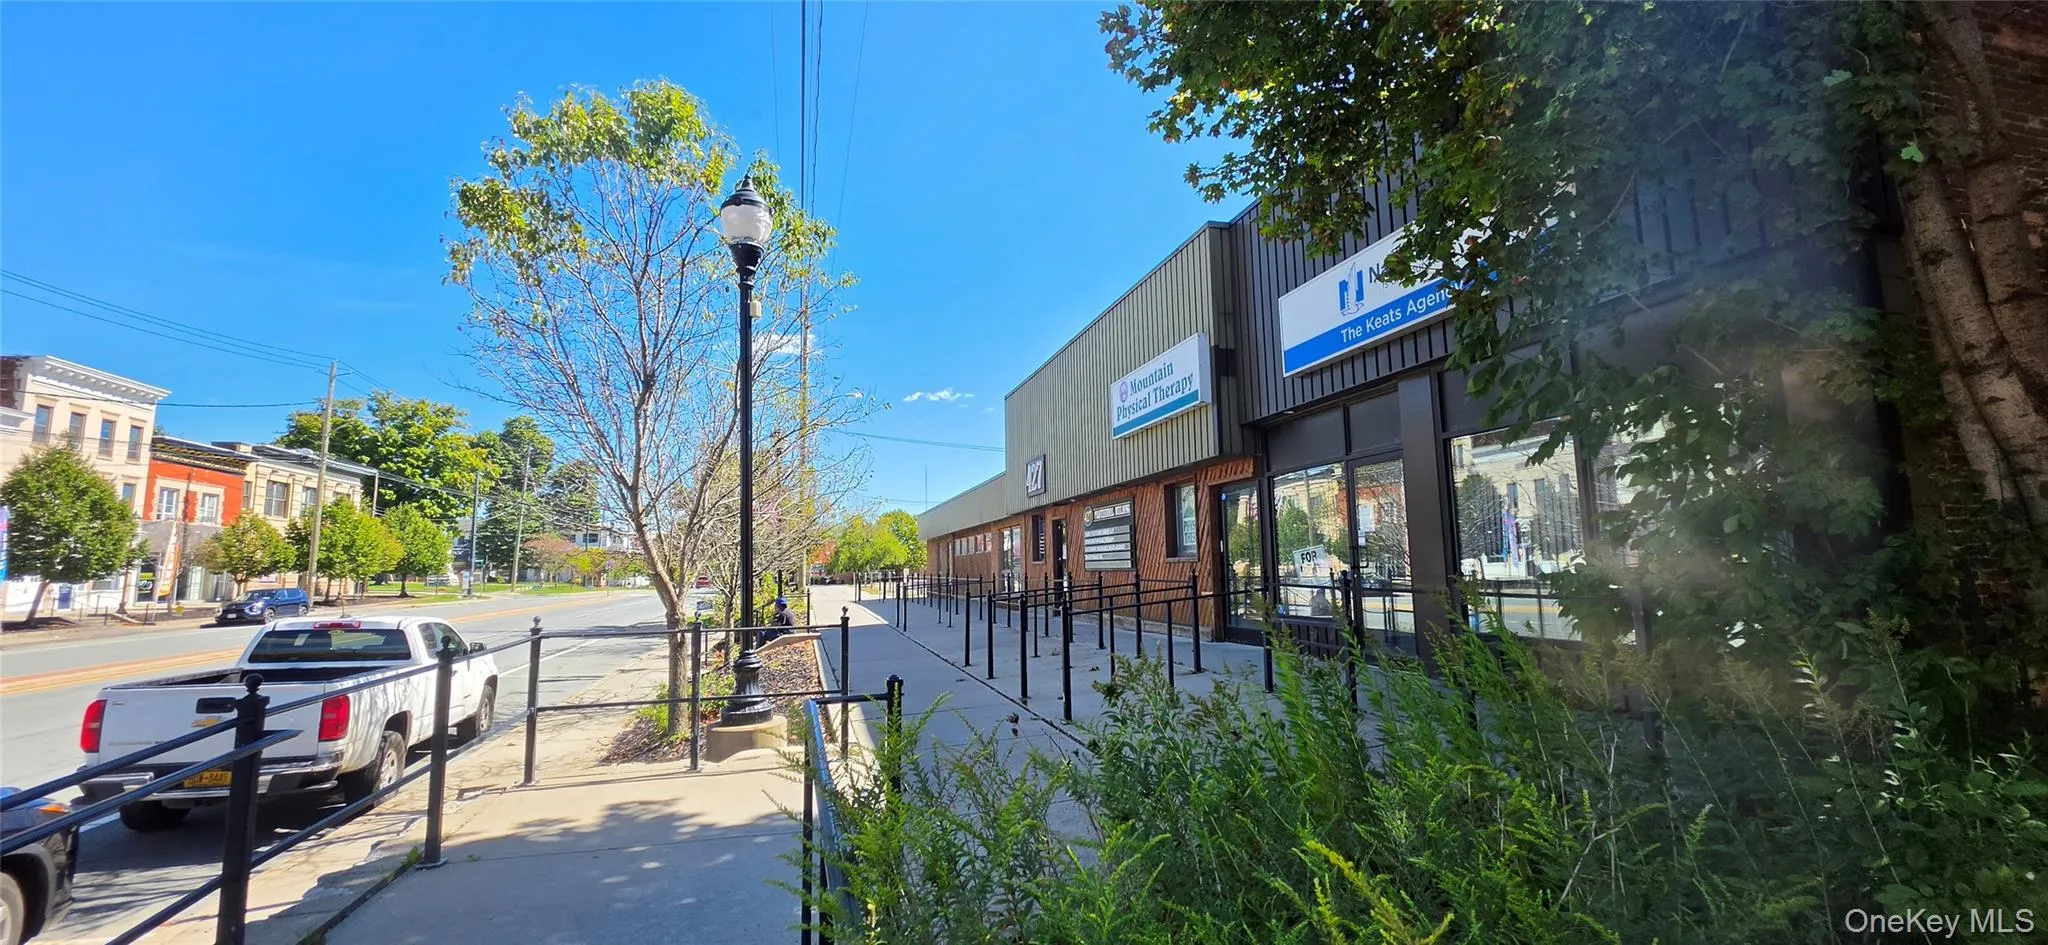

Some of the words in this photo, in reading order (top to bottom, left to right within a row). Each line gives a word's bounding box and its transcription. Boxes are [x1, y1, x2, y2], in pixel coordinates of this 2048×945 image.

[1341, 325, 1362, 342] The
[1366, 309, 1402, 333] Keats
[1130, 361, 1174, 396] Mountain
[1116, 392, 1151, 421] Physical
[1153, 373, 1194, 405] Therapy
[1027, 460, 1042, 493] 427
[1301, 550, 1317, 564] FOR
